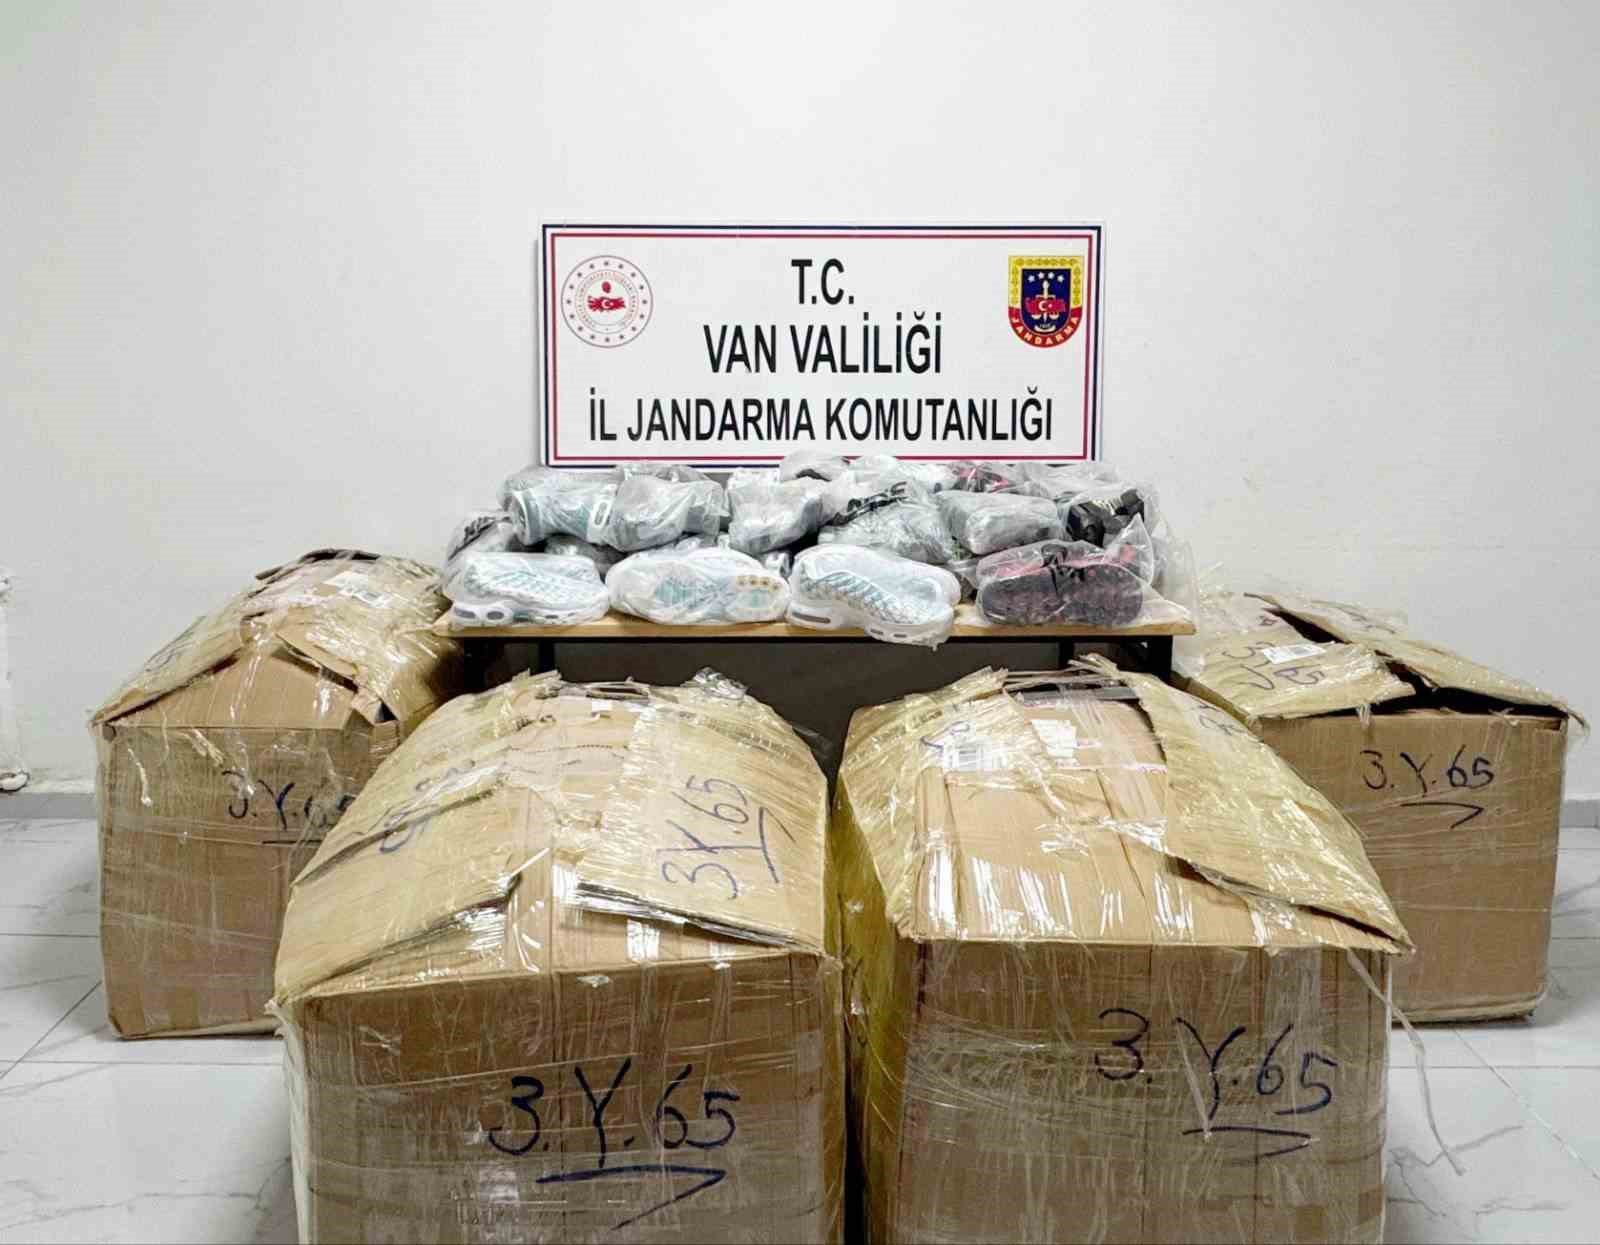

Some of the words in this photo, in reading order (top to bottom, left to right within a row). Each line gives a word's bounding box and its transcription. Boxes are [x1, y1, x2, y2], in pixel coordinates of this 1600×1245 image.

[791, 258, 854, 304] T.C.
[703, 324, 777, 373] VAN
[789, 311, 941, 373] VALİLİĞİ
[1010, 316, 1080, 345] JANDARMA
[590, 387, 617, 441] İL
[627, 398, 816, 441] JANDARMA
[826, 387, 1052, 441] KOMUTANLIĞI
[1359, 744, 1495, 798] 3.Y.65
[1094, 1007, 1339, 1121] 3.Y.65
[488, 1057, 741, 1168] 3.Y.65
